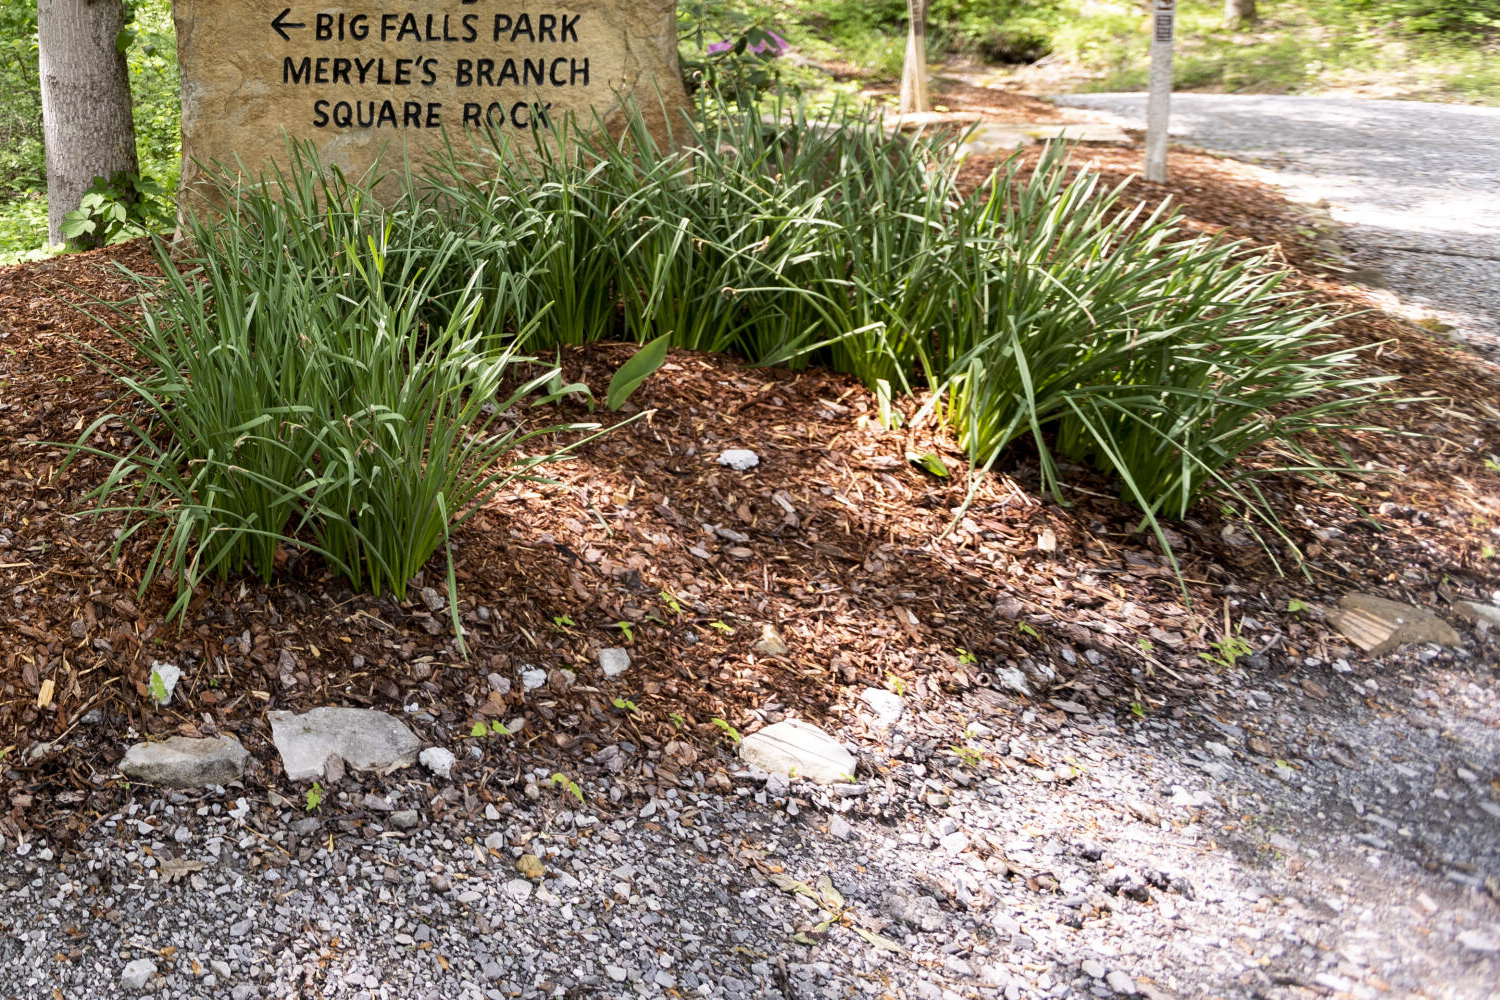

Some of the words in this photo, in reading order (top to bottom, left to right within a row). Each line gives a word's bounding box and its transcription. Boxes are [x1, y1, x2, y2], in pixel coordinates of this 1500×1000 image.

[315, 13, 370, 42] BIG
[380, 12, 479, 43] FALLS
[492, 13, 581, 44] PARK
[282, 56, 439, 86] MERYLE'S
[455, 57, 590, 87] BRANCH
[312, 99, 442, 129] SQUARE
[462, 101, 553, 130] ROCK
